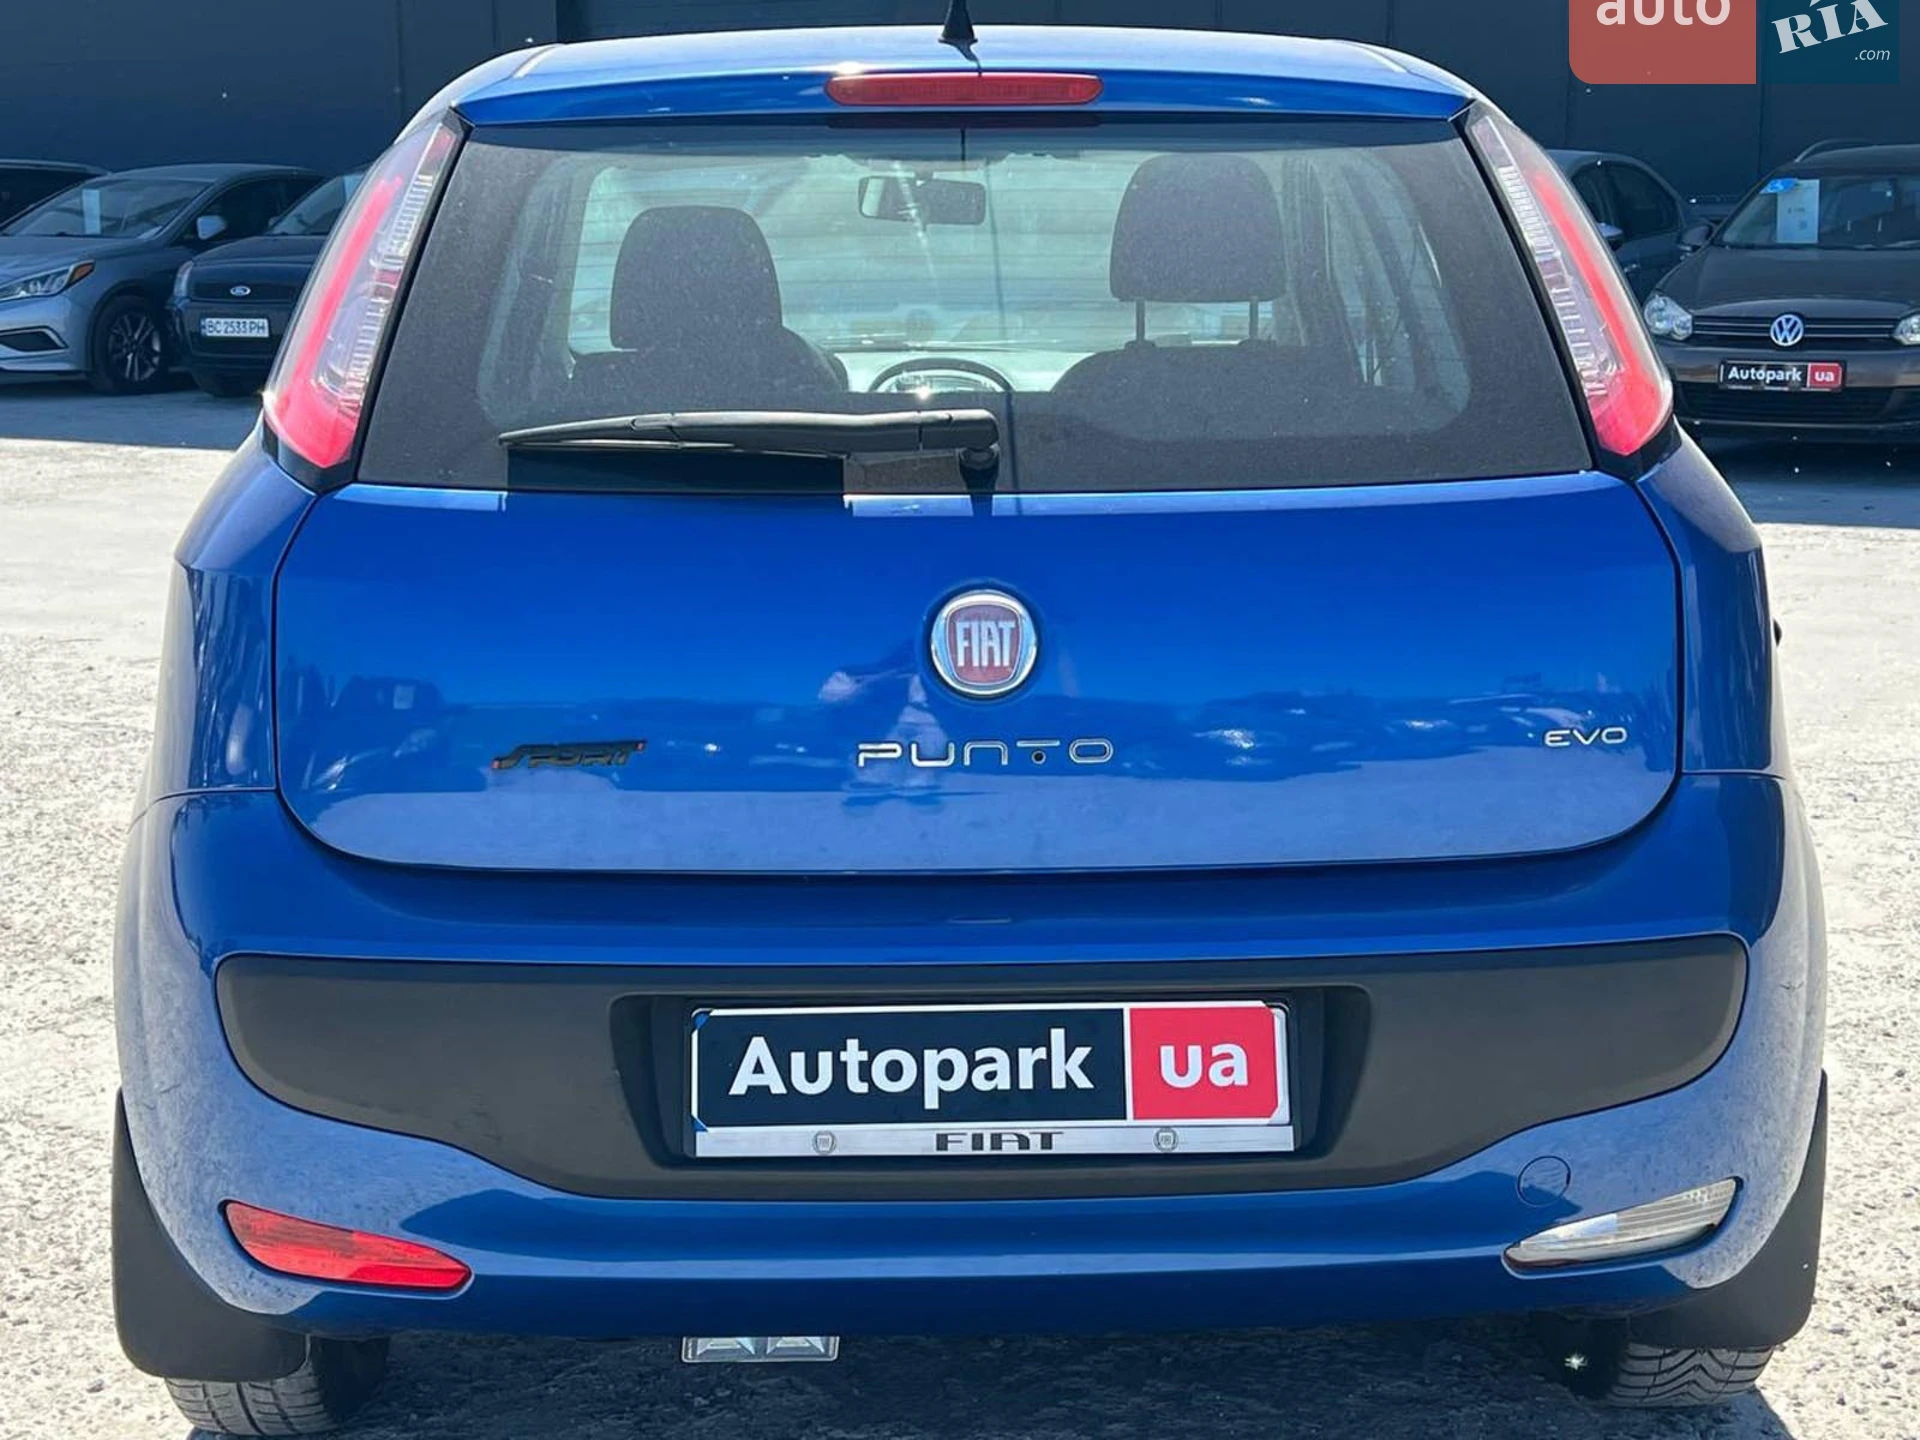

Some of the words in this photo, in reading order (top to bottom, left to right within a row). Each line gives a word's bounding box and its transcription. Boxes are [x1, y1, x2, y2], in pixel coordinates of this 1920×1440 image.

[1727, 366, 1802, 384] Autopark
[1814, 370, 1836, 382] ua
[954, 620, 1017, 668] FIAT
[1543, 726, 1628, 747] EVO
[856, 737, 1114, 768] PUNTO
[728, 1028, 1094, 1110] Autopark
[1160, 1042, 1249, 1089] ua
[935, 1130, 1065, 1153] FIAT
